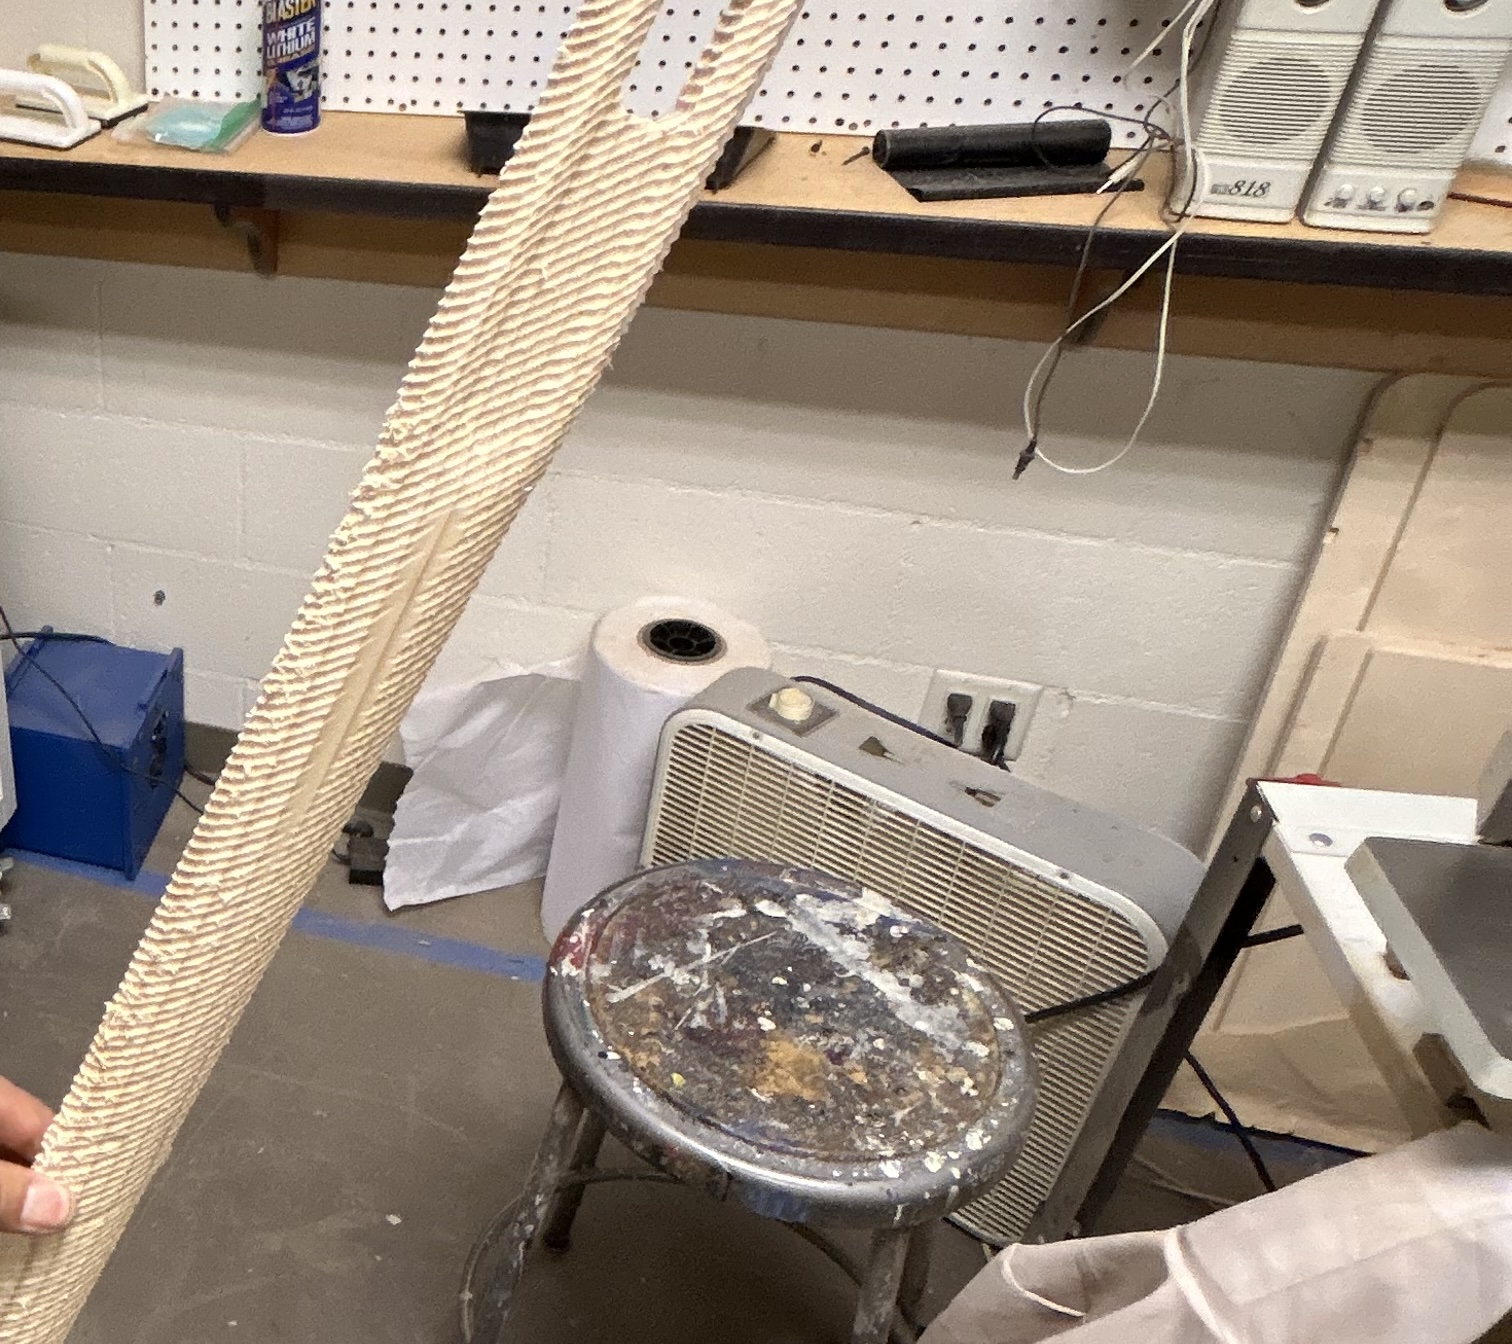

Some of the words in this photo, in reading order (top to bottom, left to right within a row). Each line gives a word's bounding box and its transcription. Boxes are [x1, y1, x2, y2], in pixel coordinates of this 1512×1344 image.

[266, 17, 316, 46] WHITE
[266, 32, 316, 60] LITHIUM
[1229, 179, 1271, 198] 818
